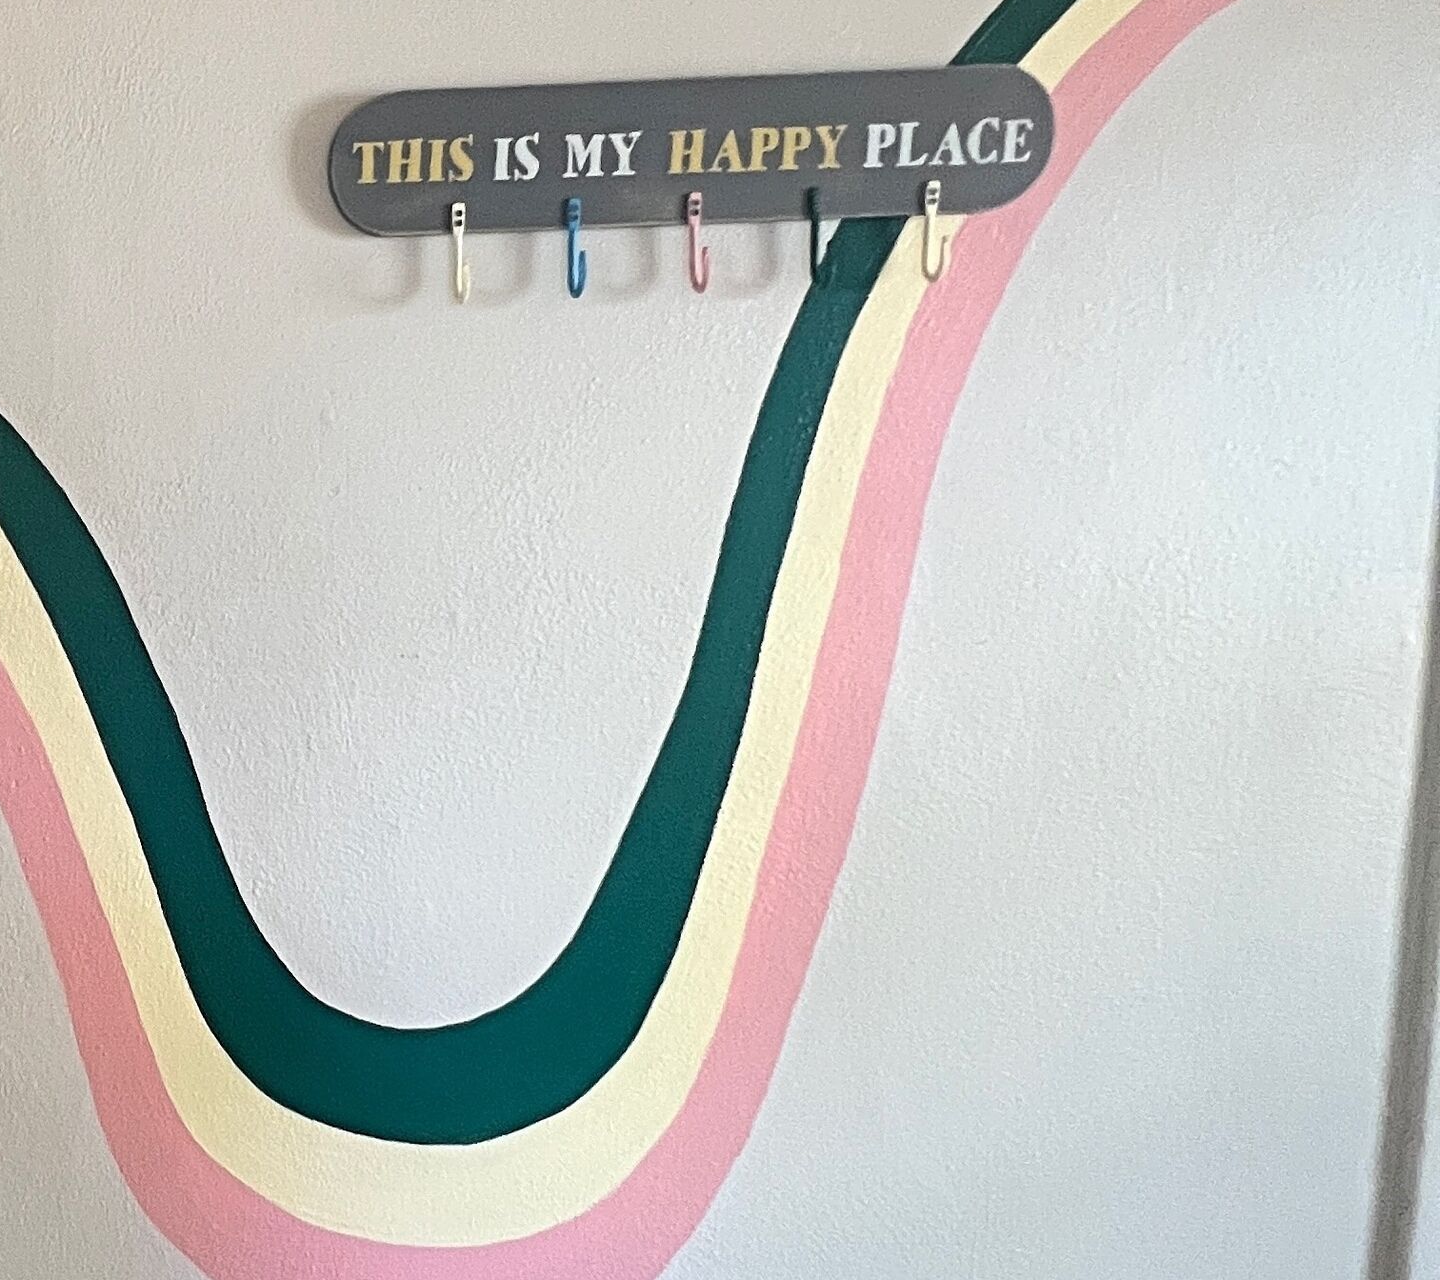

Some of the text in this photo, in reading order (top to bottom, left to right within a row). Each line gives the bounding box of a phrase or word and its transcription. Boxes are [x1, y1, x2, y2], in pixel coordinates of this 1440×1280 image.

[353, 117, 1033, 183] THIS IS MY HAPPY PLACE
